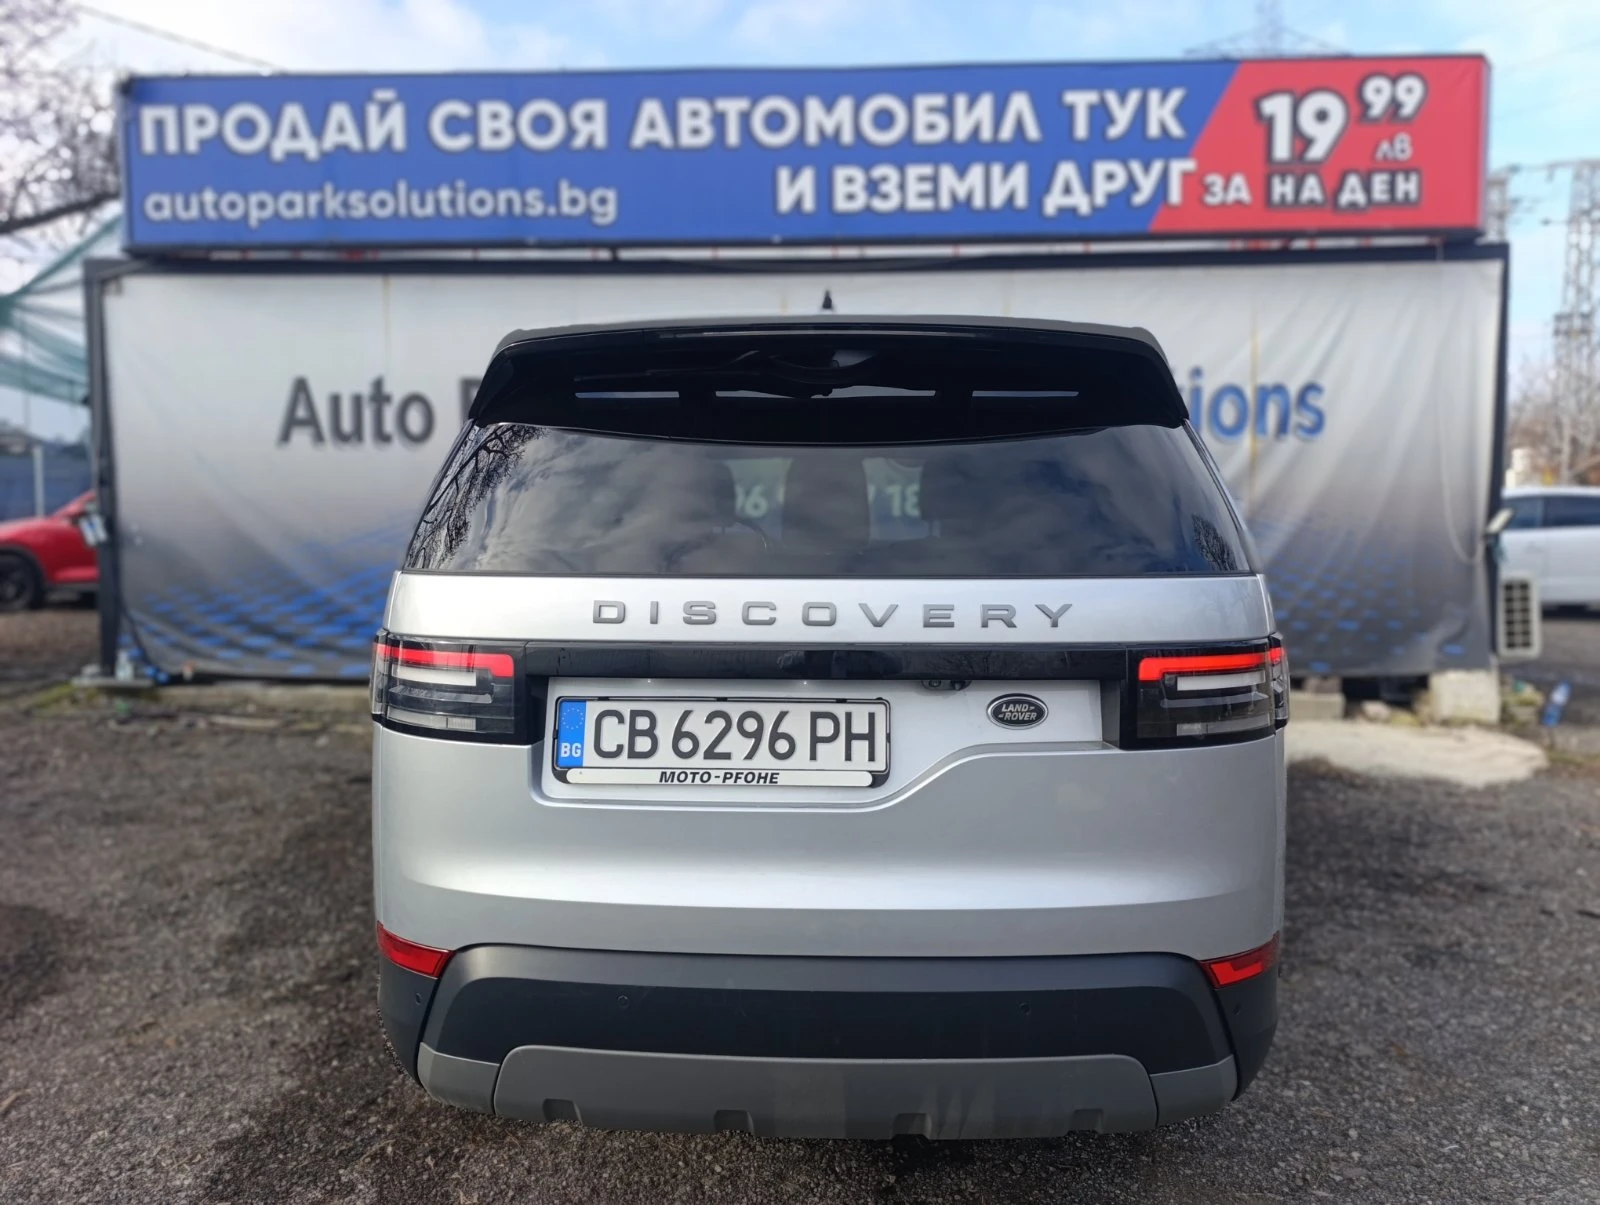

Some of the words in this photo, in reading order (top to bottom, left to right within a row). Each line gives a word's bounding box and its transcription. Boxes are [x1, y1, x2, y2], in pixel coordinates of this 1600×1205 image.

[1361, 75, 1426, 119] 99
[141, 89, 407, 162] ПРОДАЙ
[428, 98, 609, 152] СВОЯ
[629, 91, 1042, 149] АВТОМОБИЛ
[1063, 86, 1187, 142] ТУК
[1259, 91, 1347, 164] 19
[1376, 132, 1413, 162] лв
[143, 179, 618, 228] autoparksolutions.bg
[776, 165, 816, 214] И
[833, 161, 1029, 213] ВЗЕМИ
[1042, 157, 1197, 217] ДРУГ
[1203, 173, 1252, 205] ЗА
[1272, 173, 1324, 205] НА
[1338, 171, 1419, 209] ДЕН
[277, 374, 436, 445] Auto
[1180, 366, 1326, 440] ions
[592, 600, 1073, 628] DISCOVERY
[1001, 704, 1029, 712] LAND
[1004, 712, 1037, 720] ROVER
[560, 743, 581, 757] BG
[593, 709, 659, 760] CB
[671, 709, 796, 761] 6296
[809, 711, 876, 762] PH
[659, 770, 780, 785] MOTO-PFOHE
